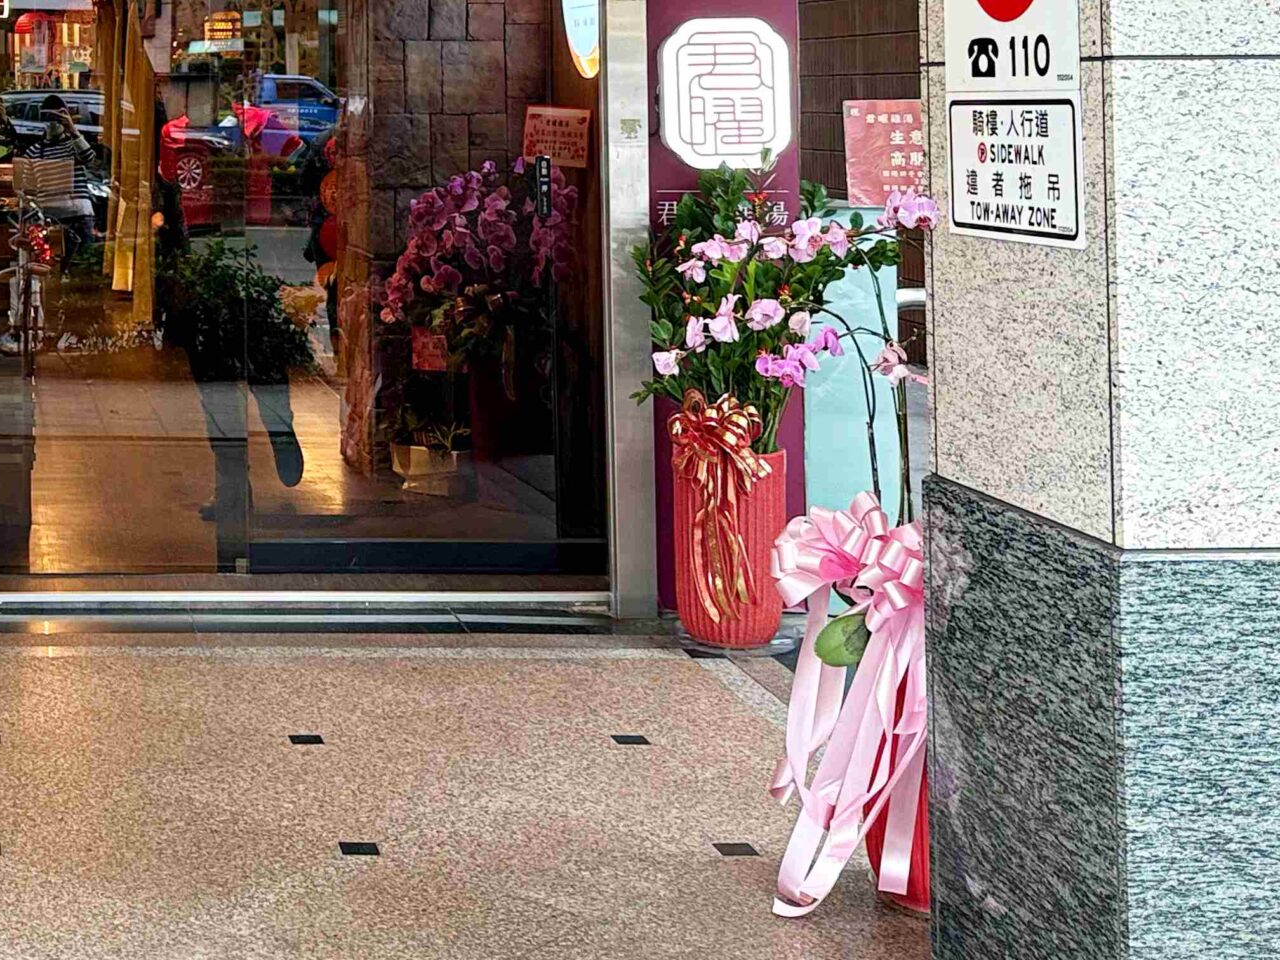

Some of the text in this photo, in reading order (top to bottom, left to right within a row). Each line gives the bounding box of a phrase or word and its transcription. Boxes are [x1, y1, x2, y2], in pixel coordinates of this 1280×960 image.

[1008, 33, 1051, 77] 110
[989, 143, 1046, 166] SIDEWALK
[966, 168, 1061, 203] 違者拖吊
[969, 201, 1058, 229] TOW-AWAY ZONE
